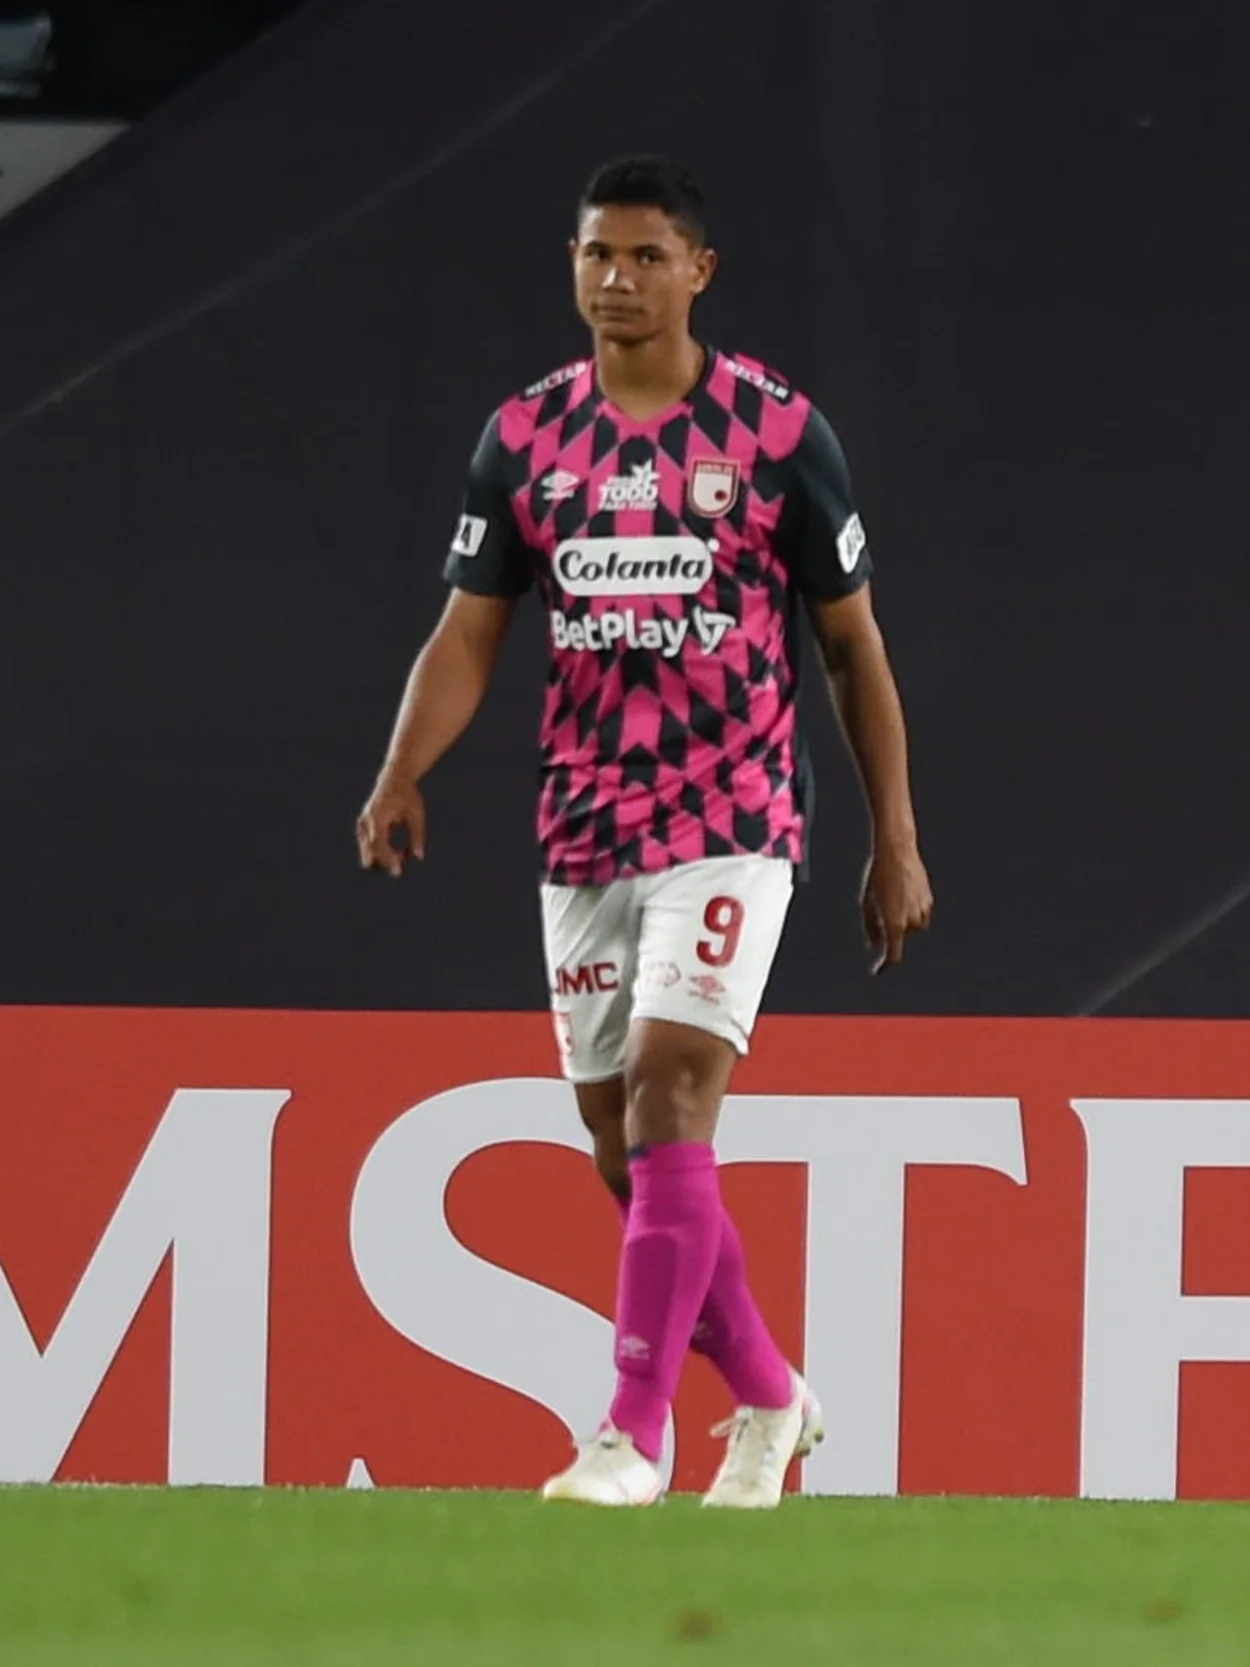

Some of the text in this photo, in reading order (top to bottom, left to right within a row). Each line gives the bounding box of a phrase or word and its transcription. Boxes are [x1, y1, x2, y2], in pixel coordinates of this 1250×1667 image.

[559, 550, 706, 582] Colanta
[550, 608, 689, 658] BetPlay
[696, 895, 745, 967] 9
